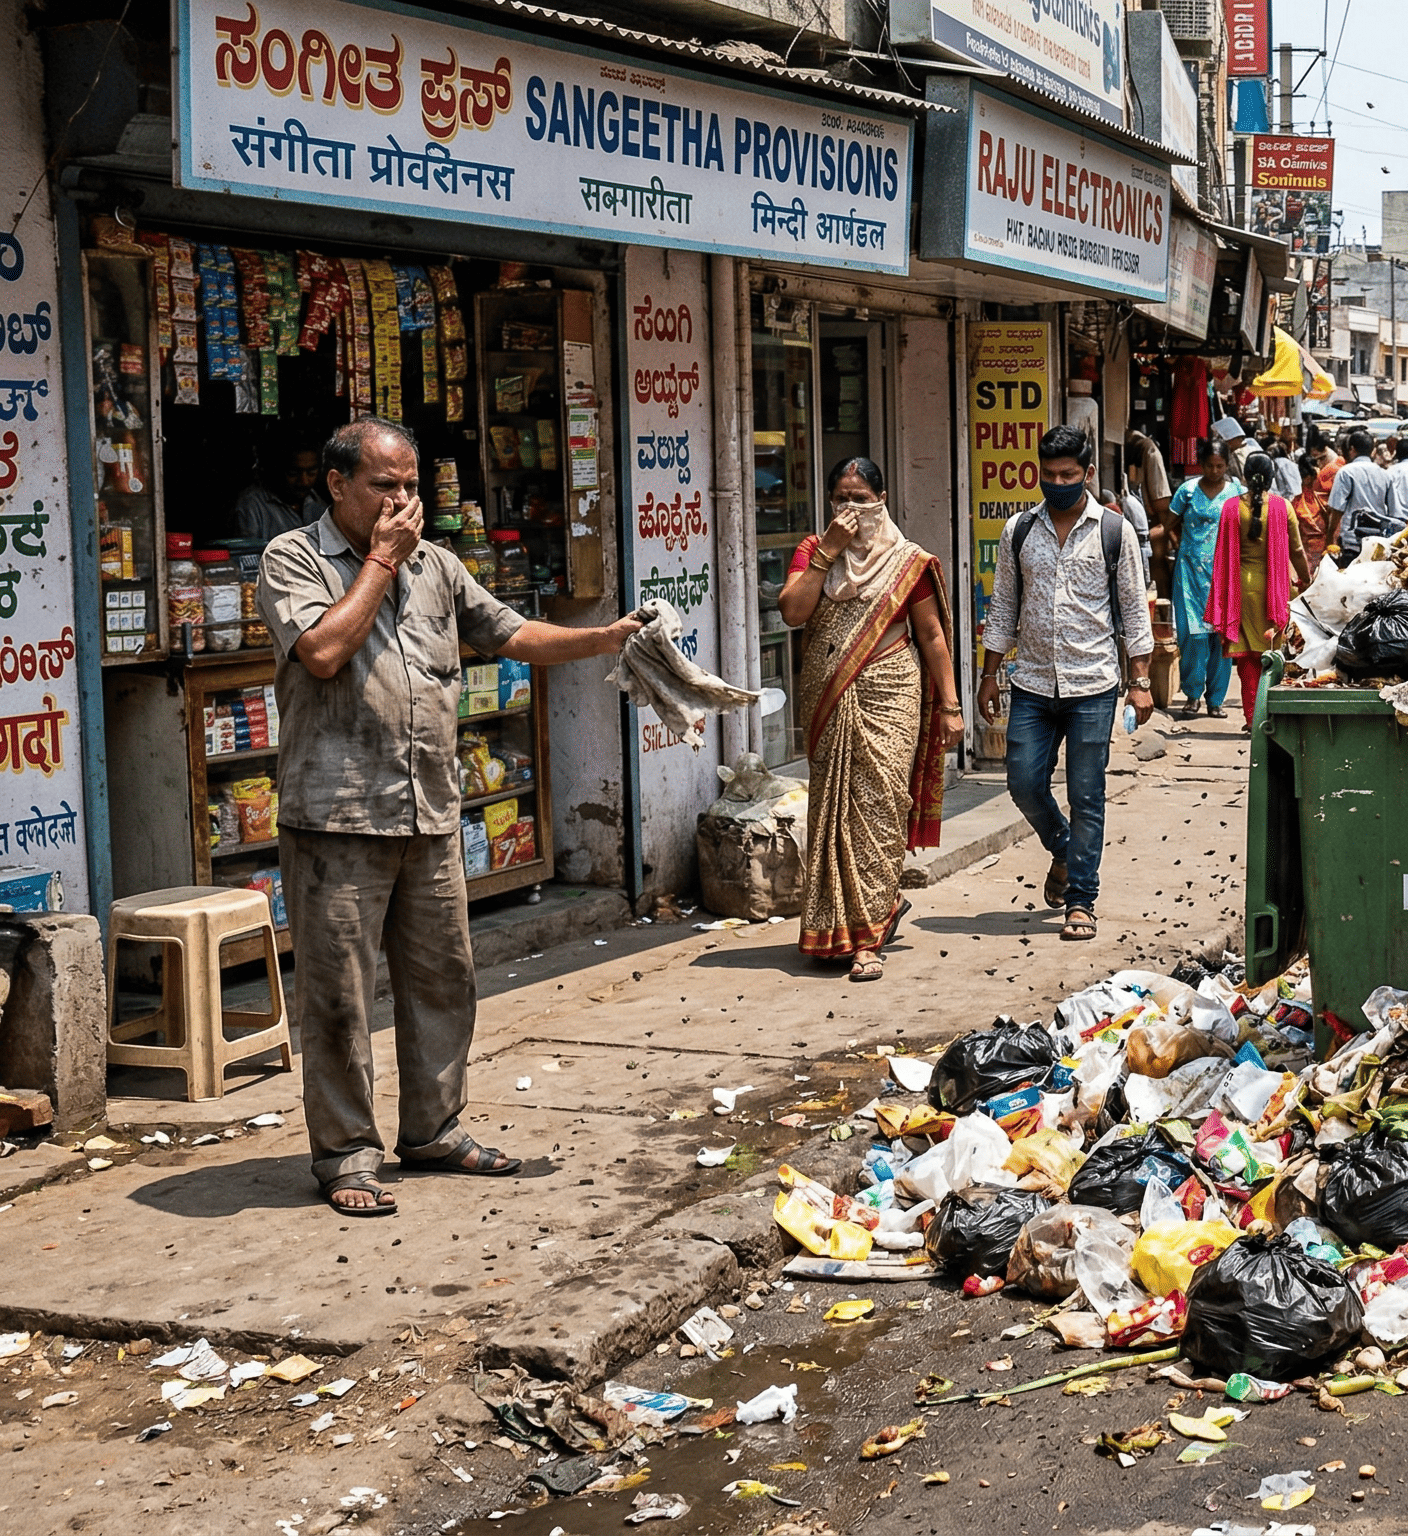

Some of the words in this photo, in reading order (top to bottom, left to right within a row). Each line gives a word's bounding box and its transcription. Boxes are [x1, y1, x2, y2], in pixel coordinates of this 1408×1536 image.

[228, 116, 356, 181] संगीता
[525, 75, 725, 172] SANGEETHA
[734, 116, 899, 202] PROVISIONS
[978, 129, 1036, 206] RAJU
[1041, 153, 1163, 246] ELECTRONICS
[975, 381, 1042, 411] STD
[981, 460, 1040, 490] PCO
